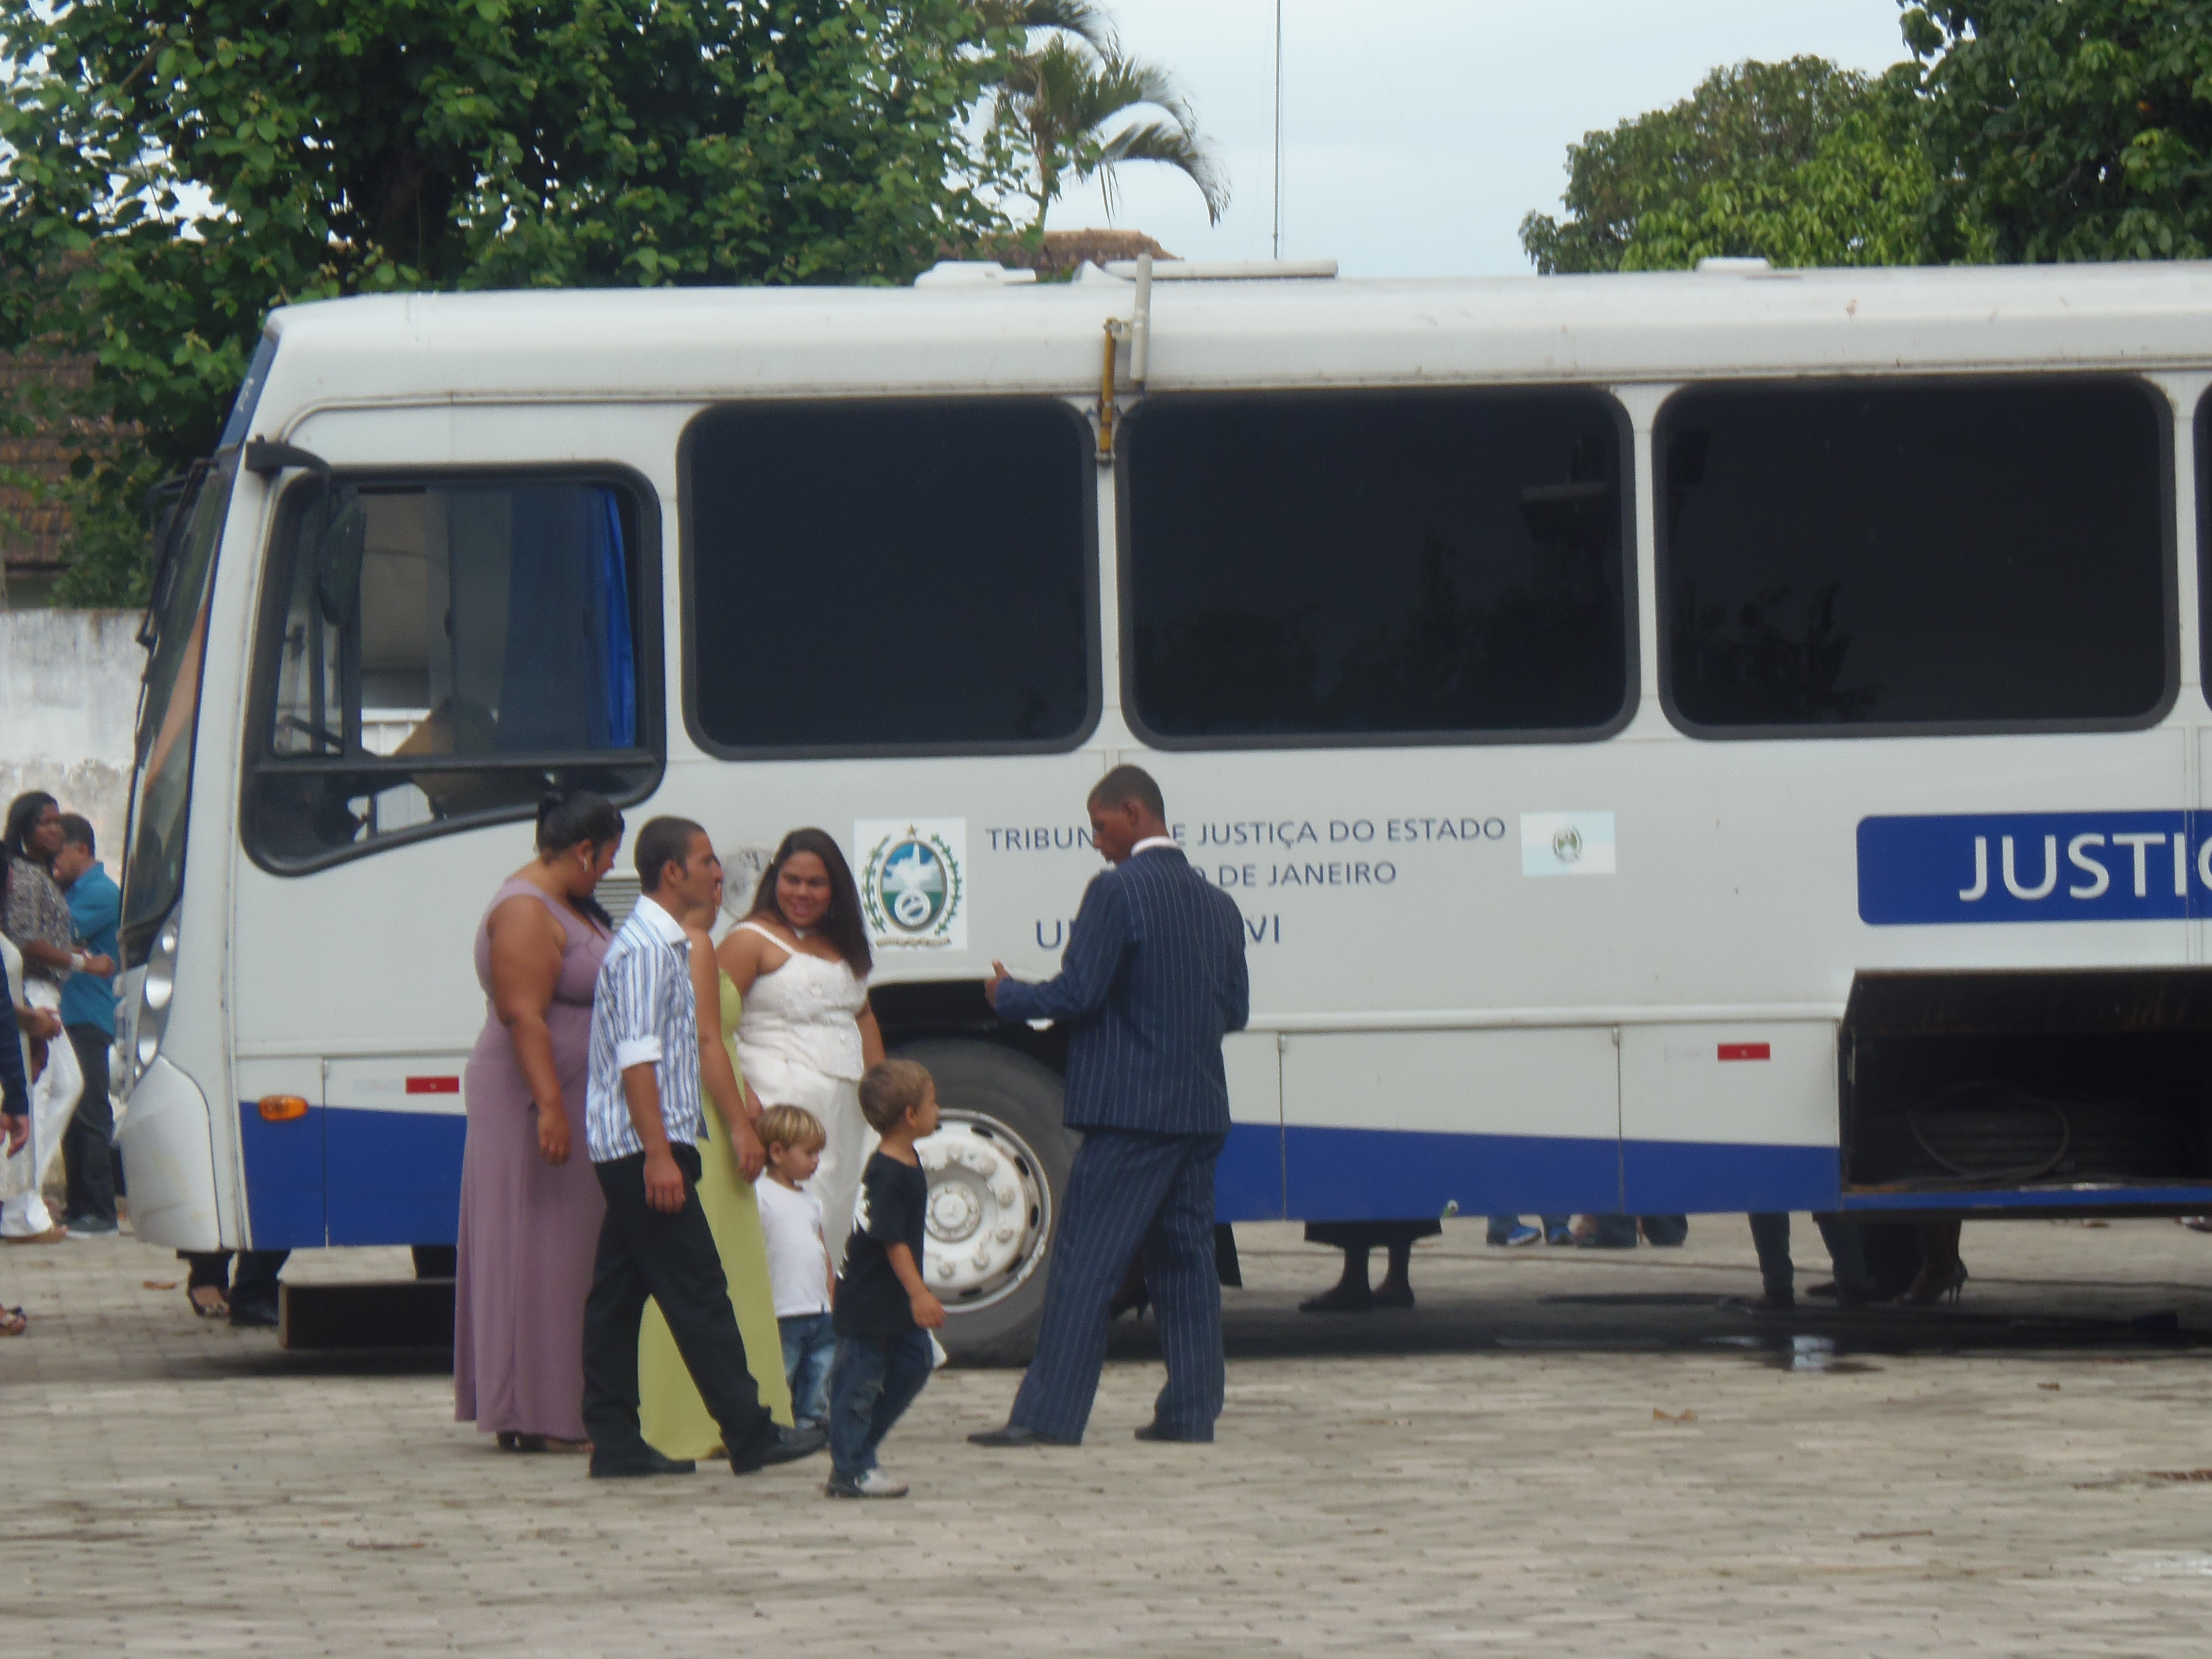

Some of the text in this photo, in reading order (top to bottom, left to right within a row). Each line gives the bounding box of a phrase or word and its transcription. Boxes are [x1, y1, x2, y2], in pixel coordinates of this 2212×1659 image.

[985, 816, 1506, 851] TRIBUN E JUSTIÇA DO ESTADO
[1218, 864, 1256, 887] DE
[1267, 860, 1397, 886] JANEIRO
